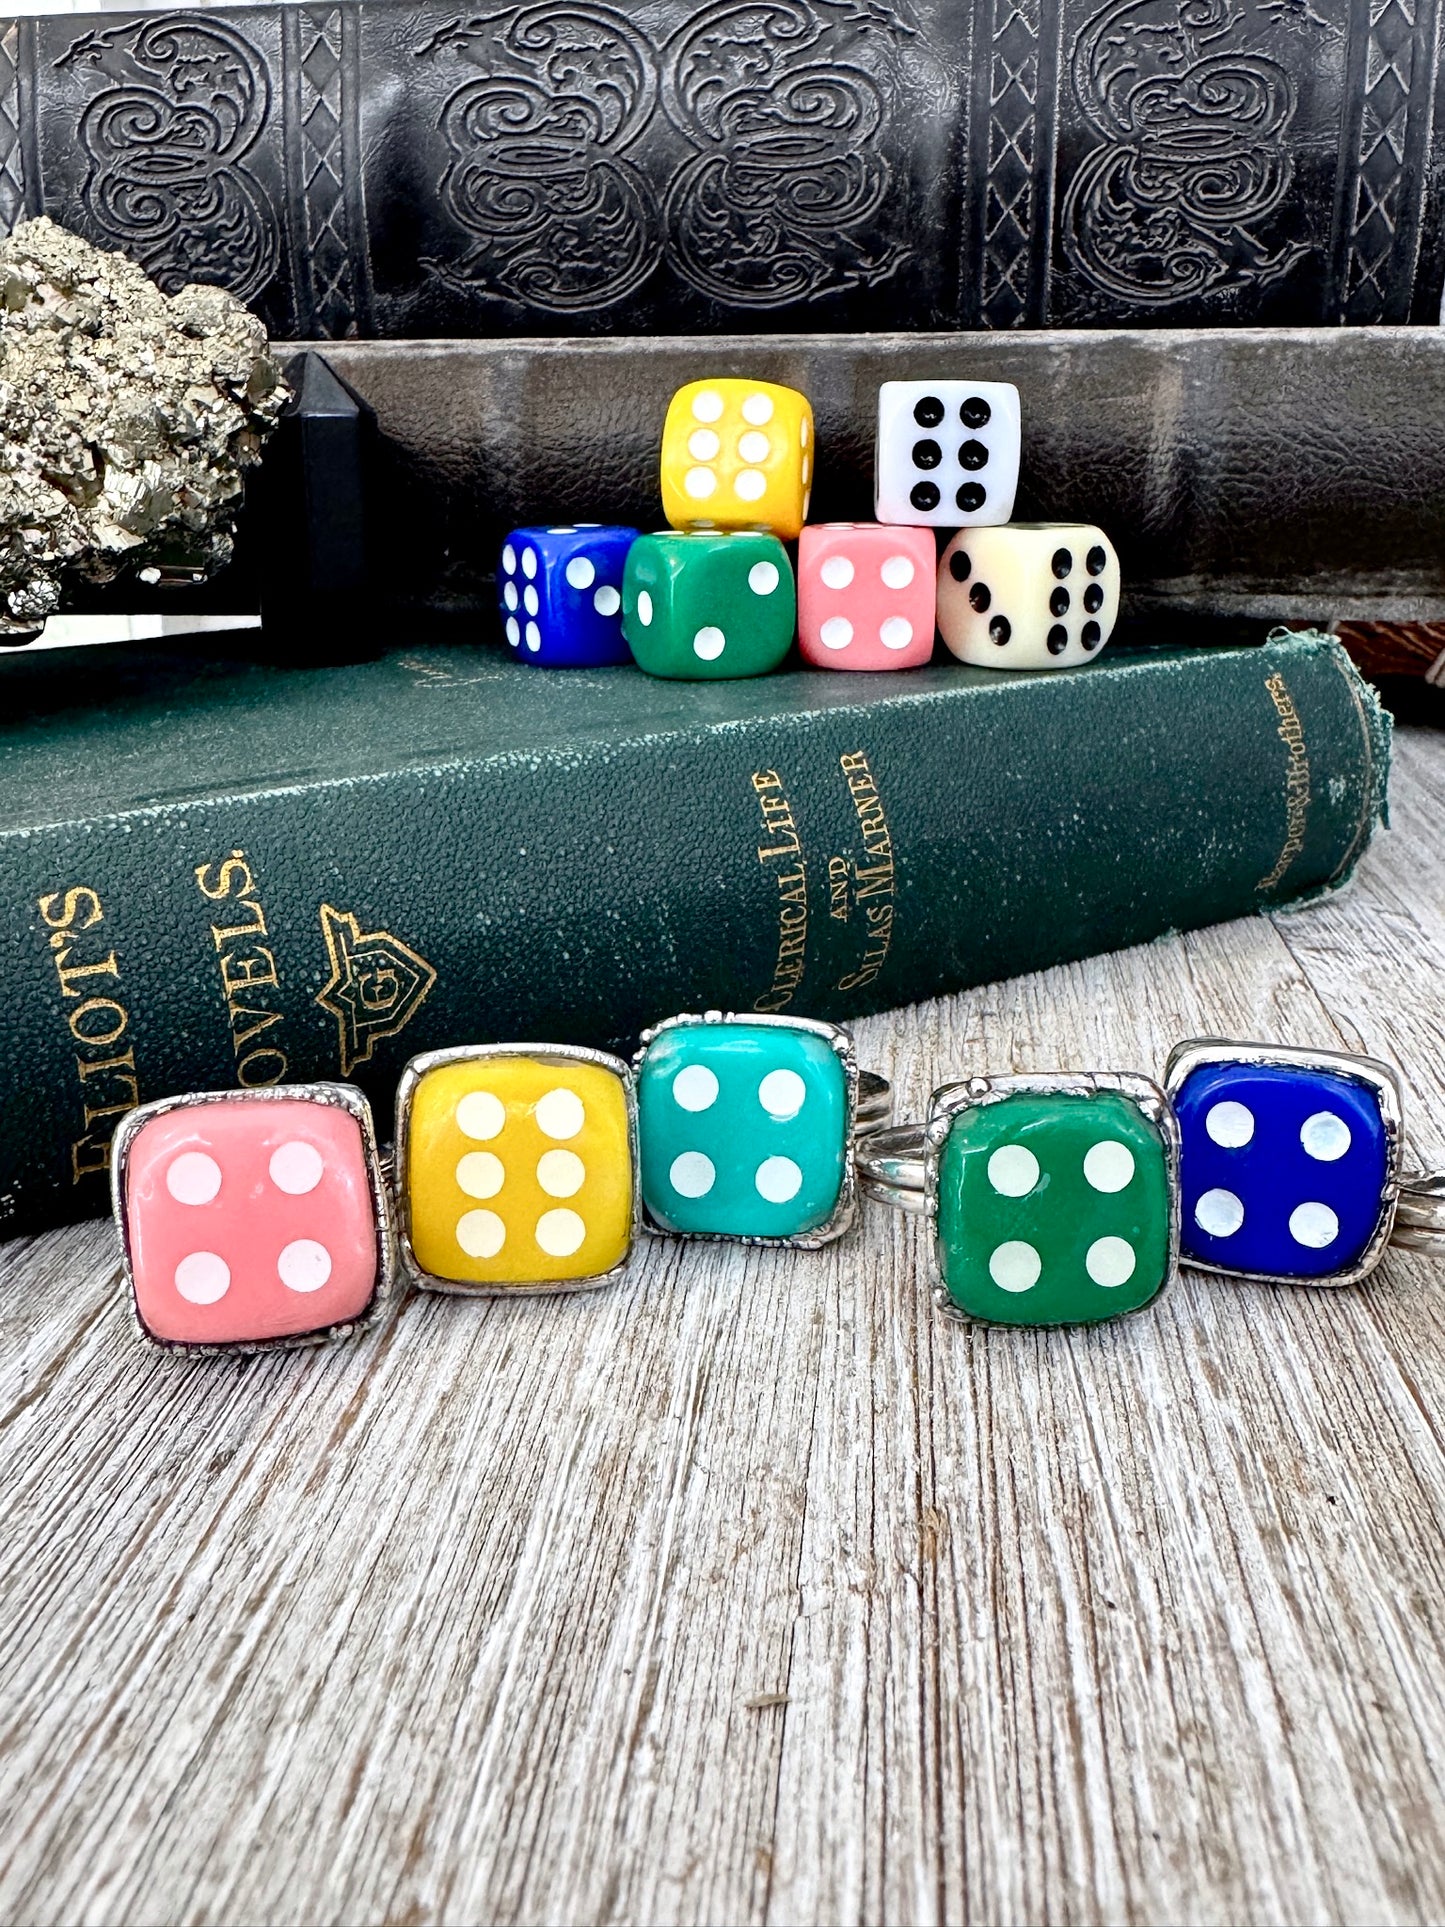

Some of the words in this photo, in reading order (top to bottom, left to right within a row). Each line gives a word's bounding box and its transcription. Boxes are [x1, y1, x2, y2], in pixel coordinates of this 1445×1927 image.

[752, 769, 801, 864] LIFE
[840, 750, 894, 905] MARNER
[753, 863, 807, 1012] CLERICAL
[829, 856, 849, 922] AND
[838, 904, 893, 990] SILAS
[195, 850, 288, 1087] OVELS.
